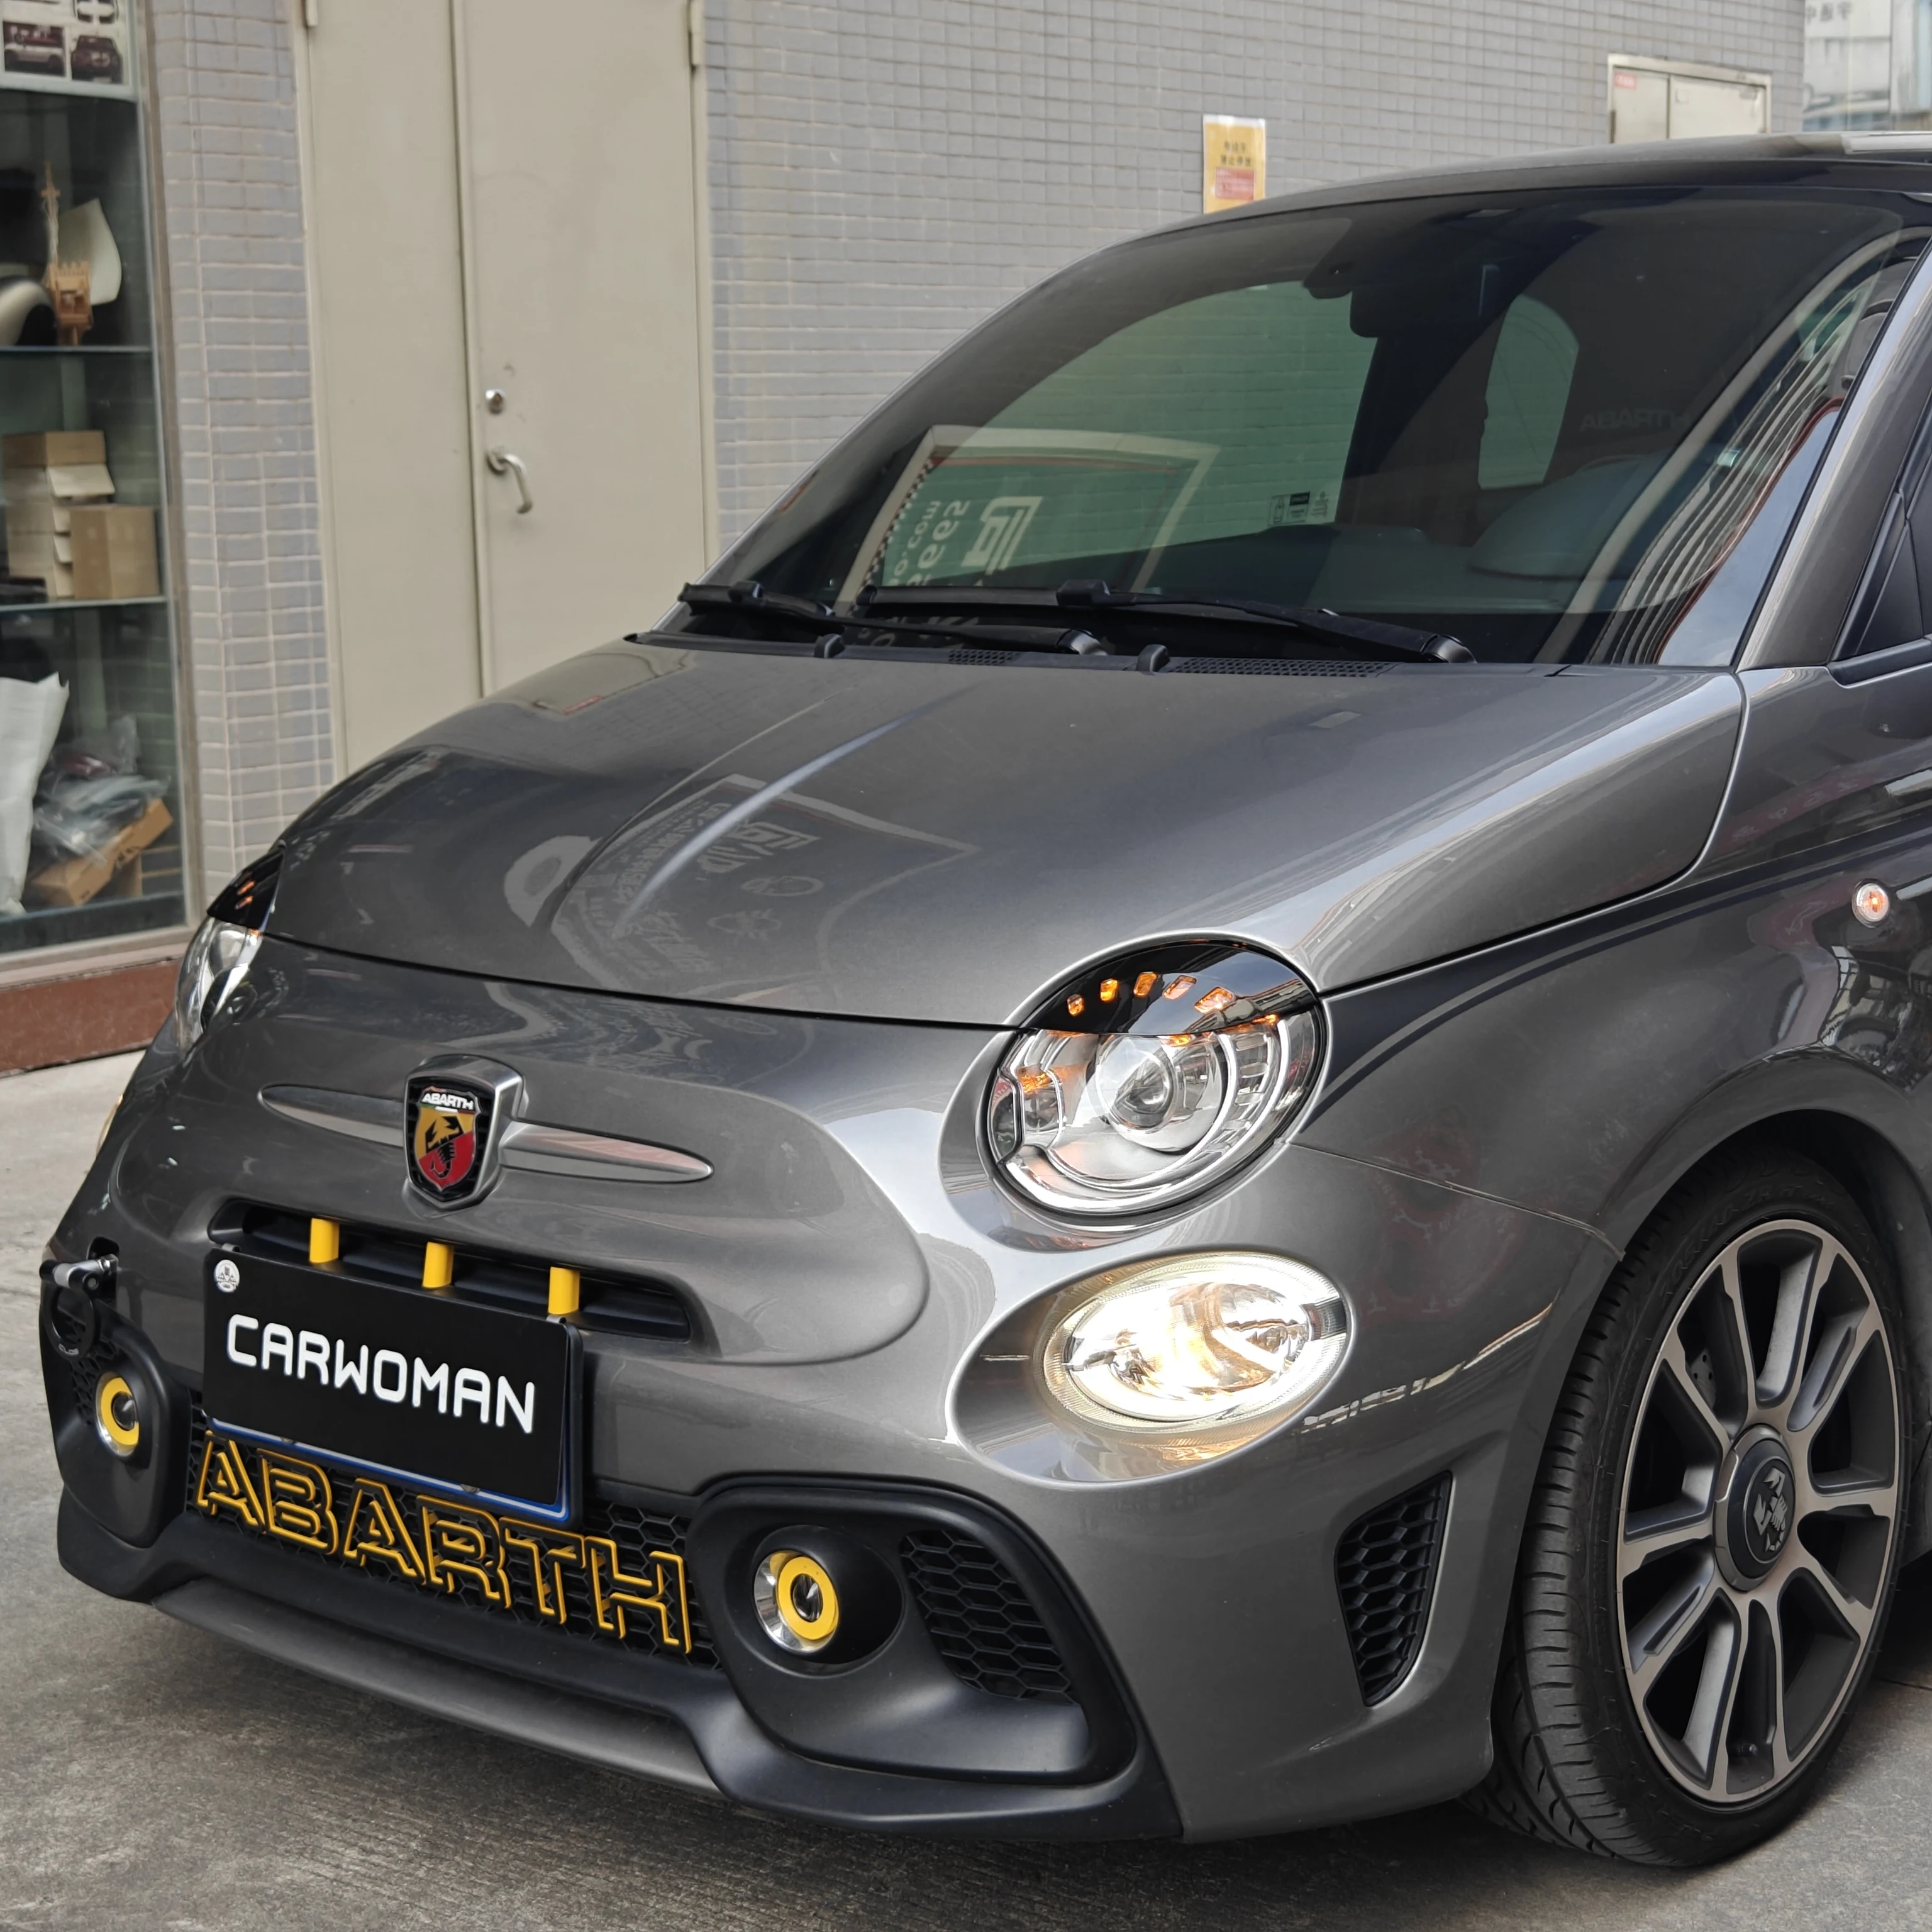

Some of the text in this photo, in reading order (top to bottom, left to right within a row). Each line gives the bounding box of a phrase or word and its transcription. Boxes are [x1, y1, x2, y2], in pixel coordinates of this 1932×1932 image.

[1579, 408, 1692, 432] ABARTH
[421, 1092, 474, 1109] ABARTH
[228, 1314, 535, 1433] CARWOMAN
[196, 1431, 692, 1653] ABARTH
